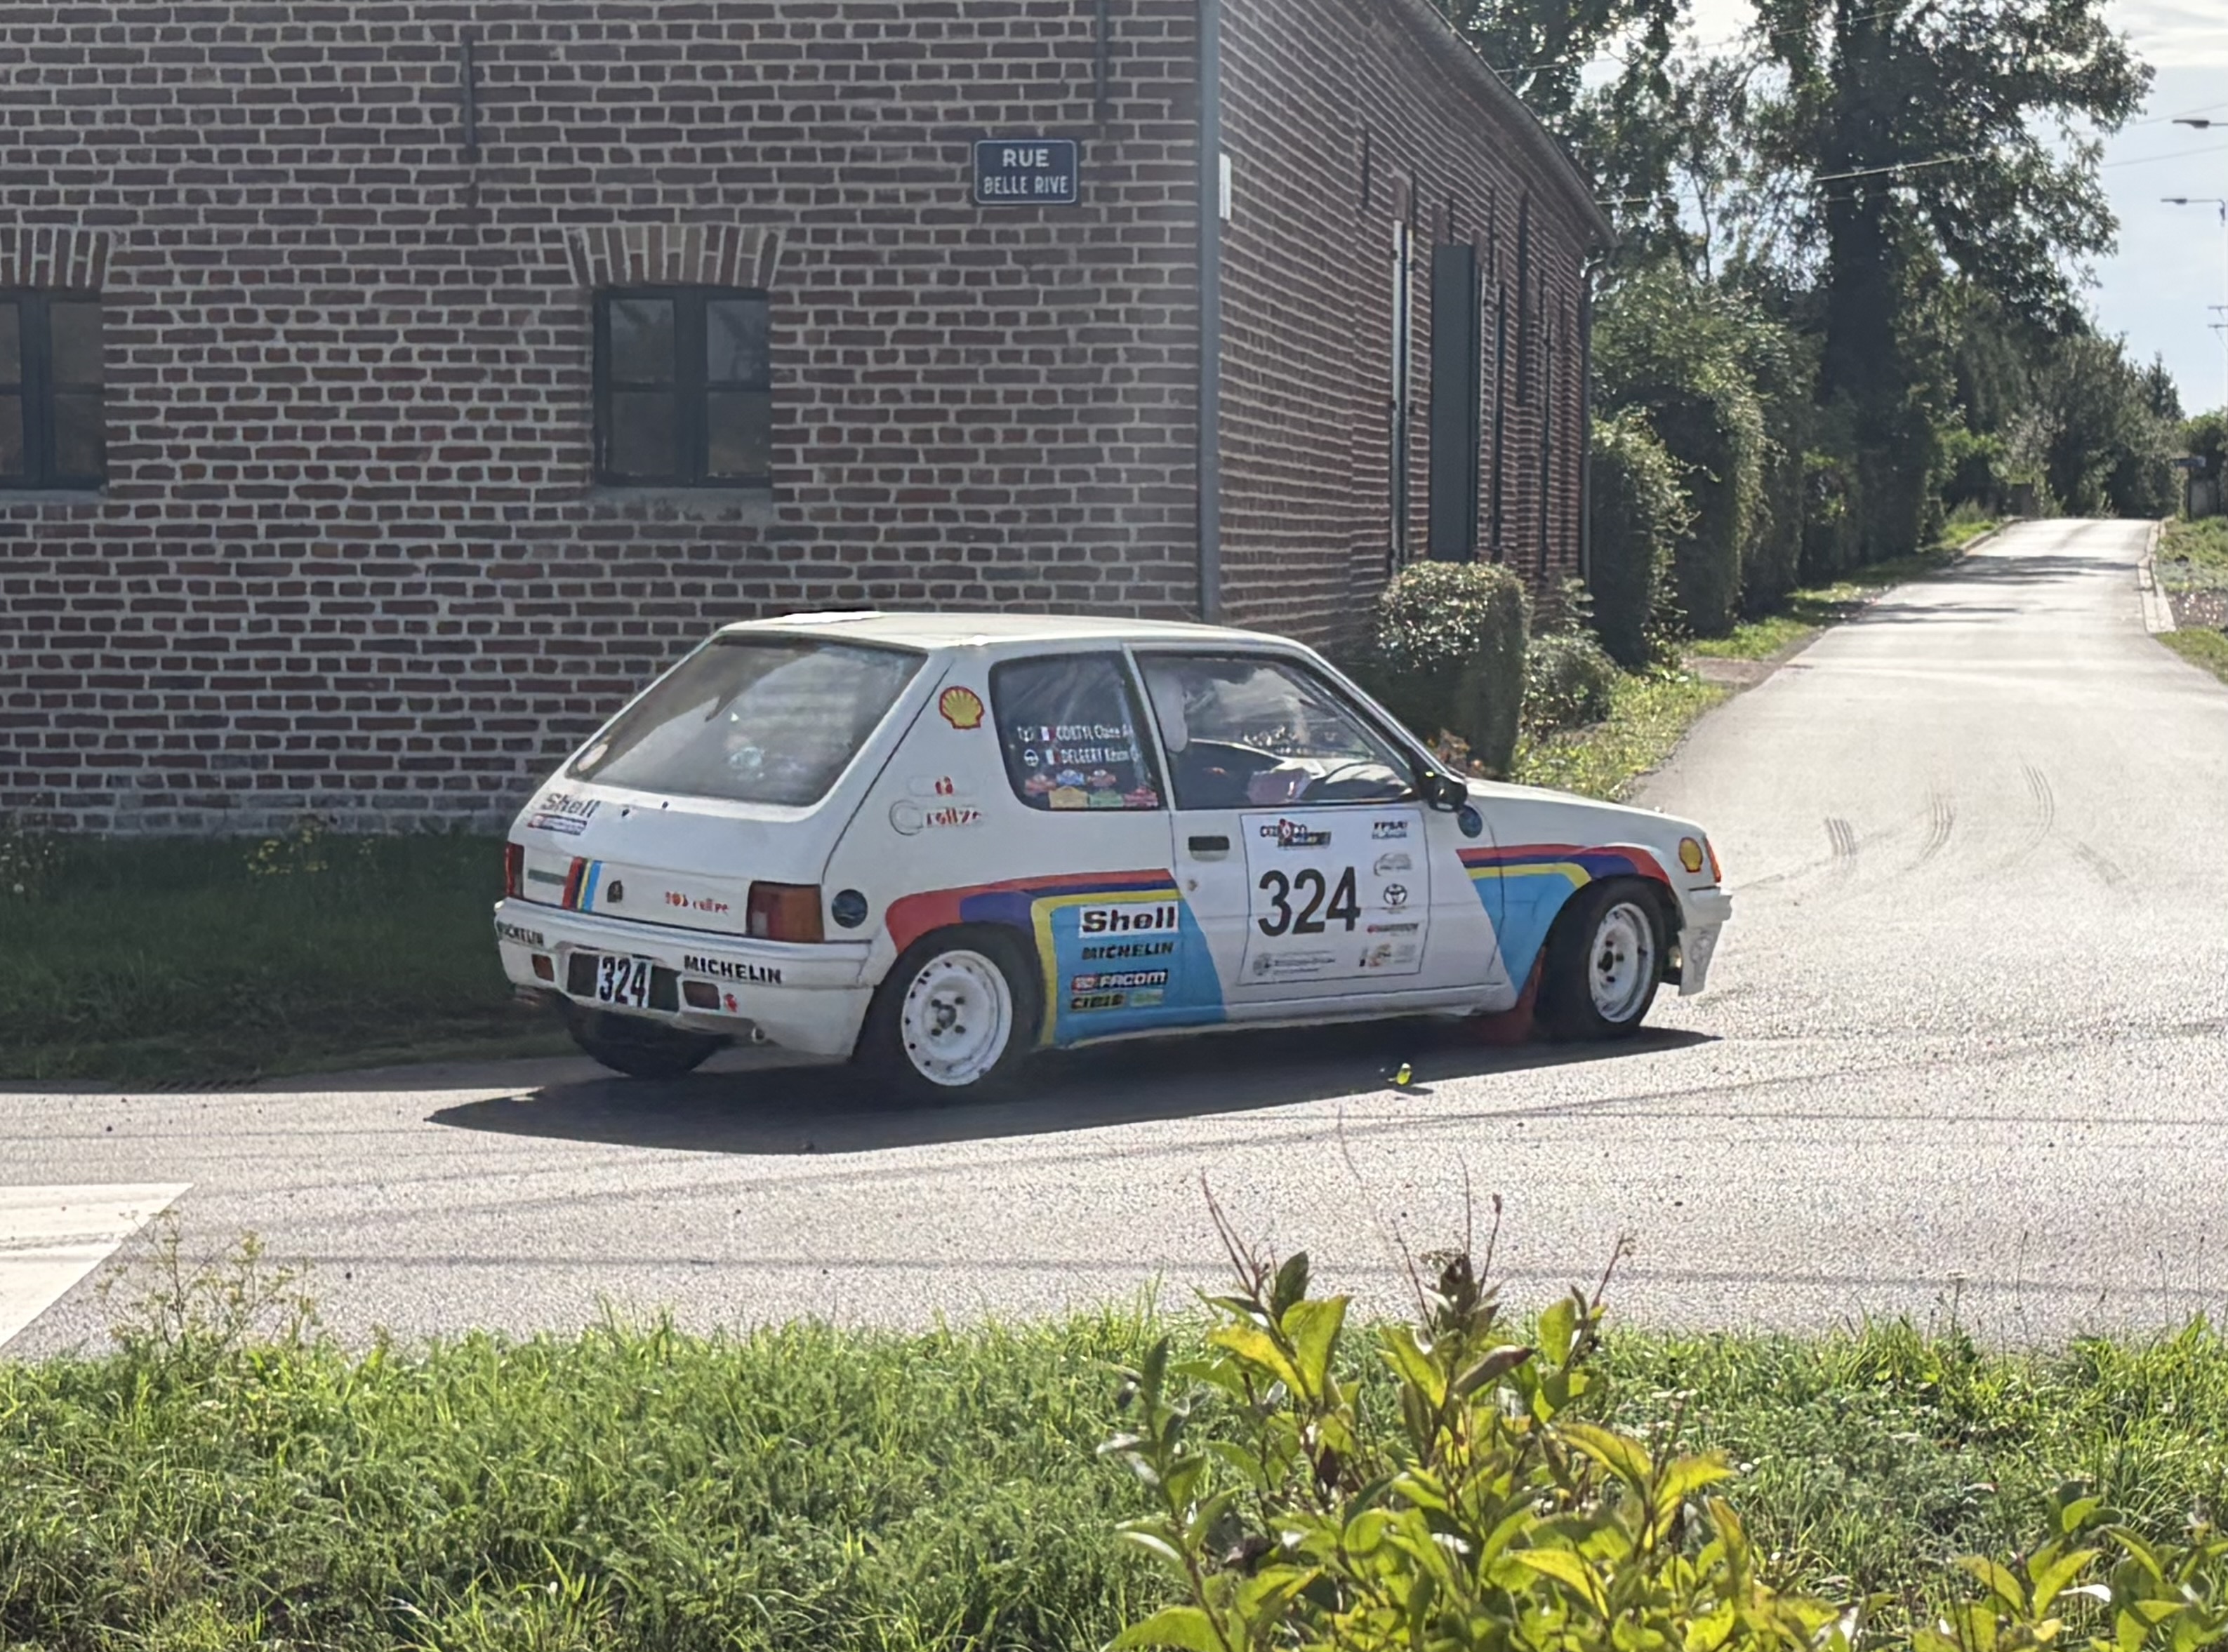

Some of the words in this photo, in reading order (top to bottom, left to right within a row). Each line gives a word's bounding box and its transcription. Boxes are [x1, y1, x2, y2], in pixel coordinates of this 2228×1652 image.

[1002, 148, 1050, 167] RUE
[983, 176, 1028, 194] BELLE
[1034, 175, 1068, 194] RIVE
[541, 793, 602, 818] Shell
[1258, 866, 1361, 937] 324
[1082, 906, 1176, 933] Shell
[1082, 942, 1174, 960] MICHELIN
[684, 954, 782, 984] MICHELIN
[599, 956, 646, 1009] 324
